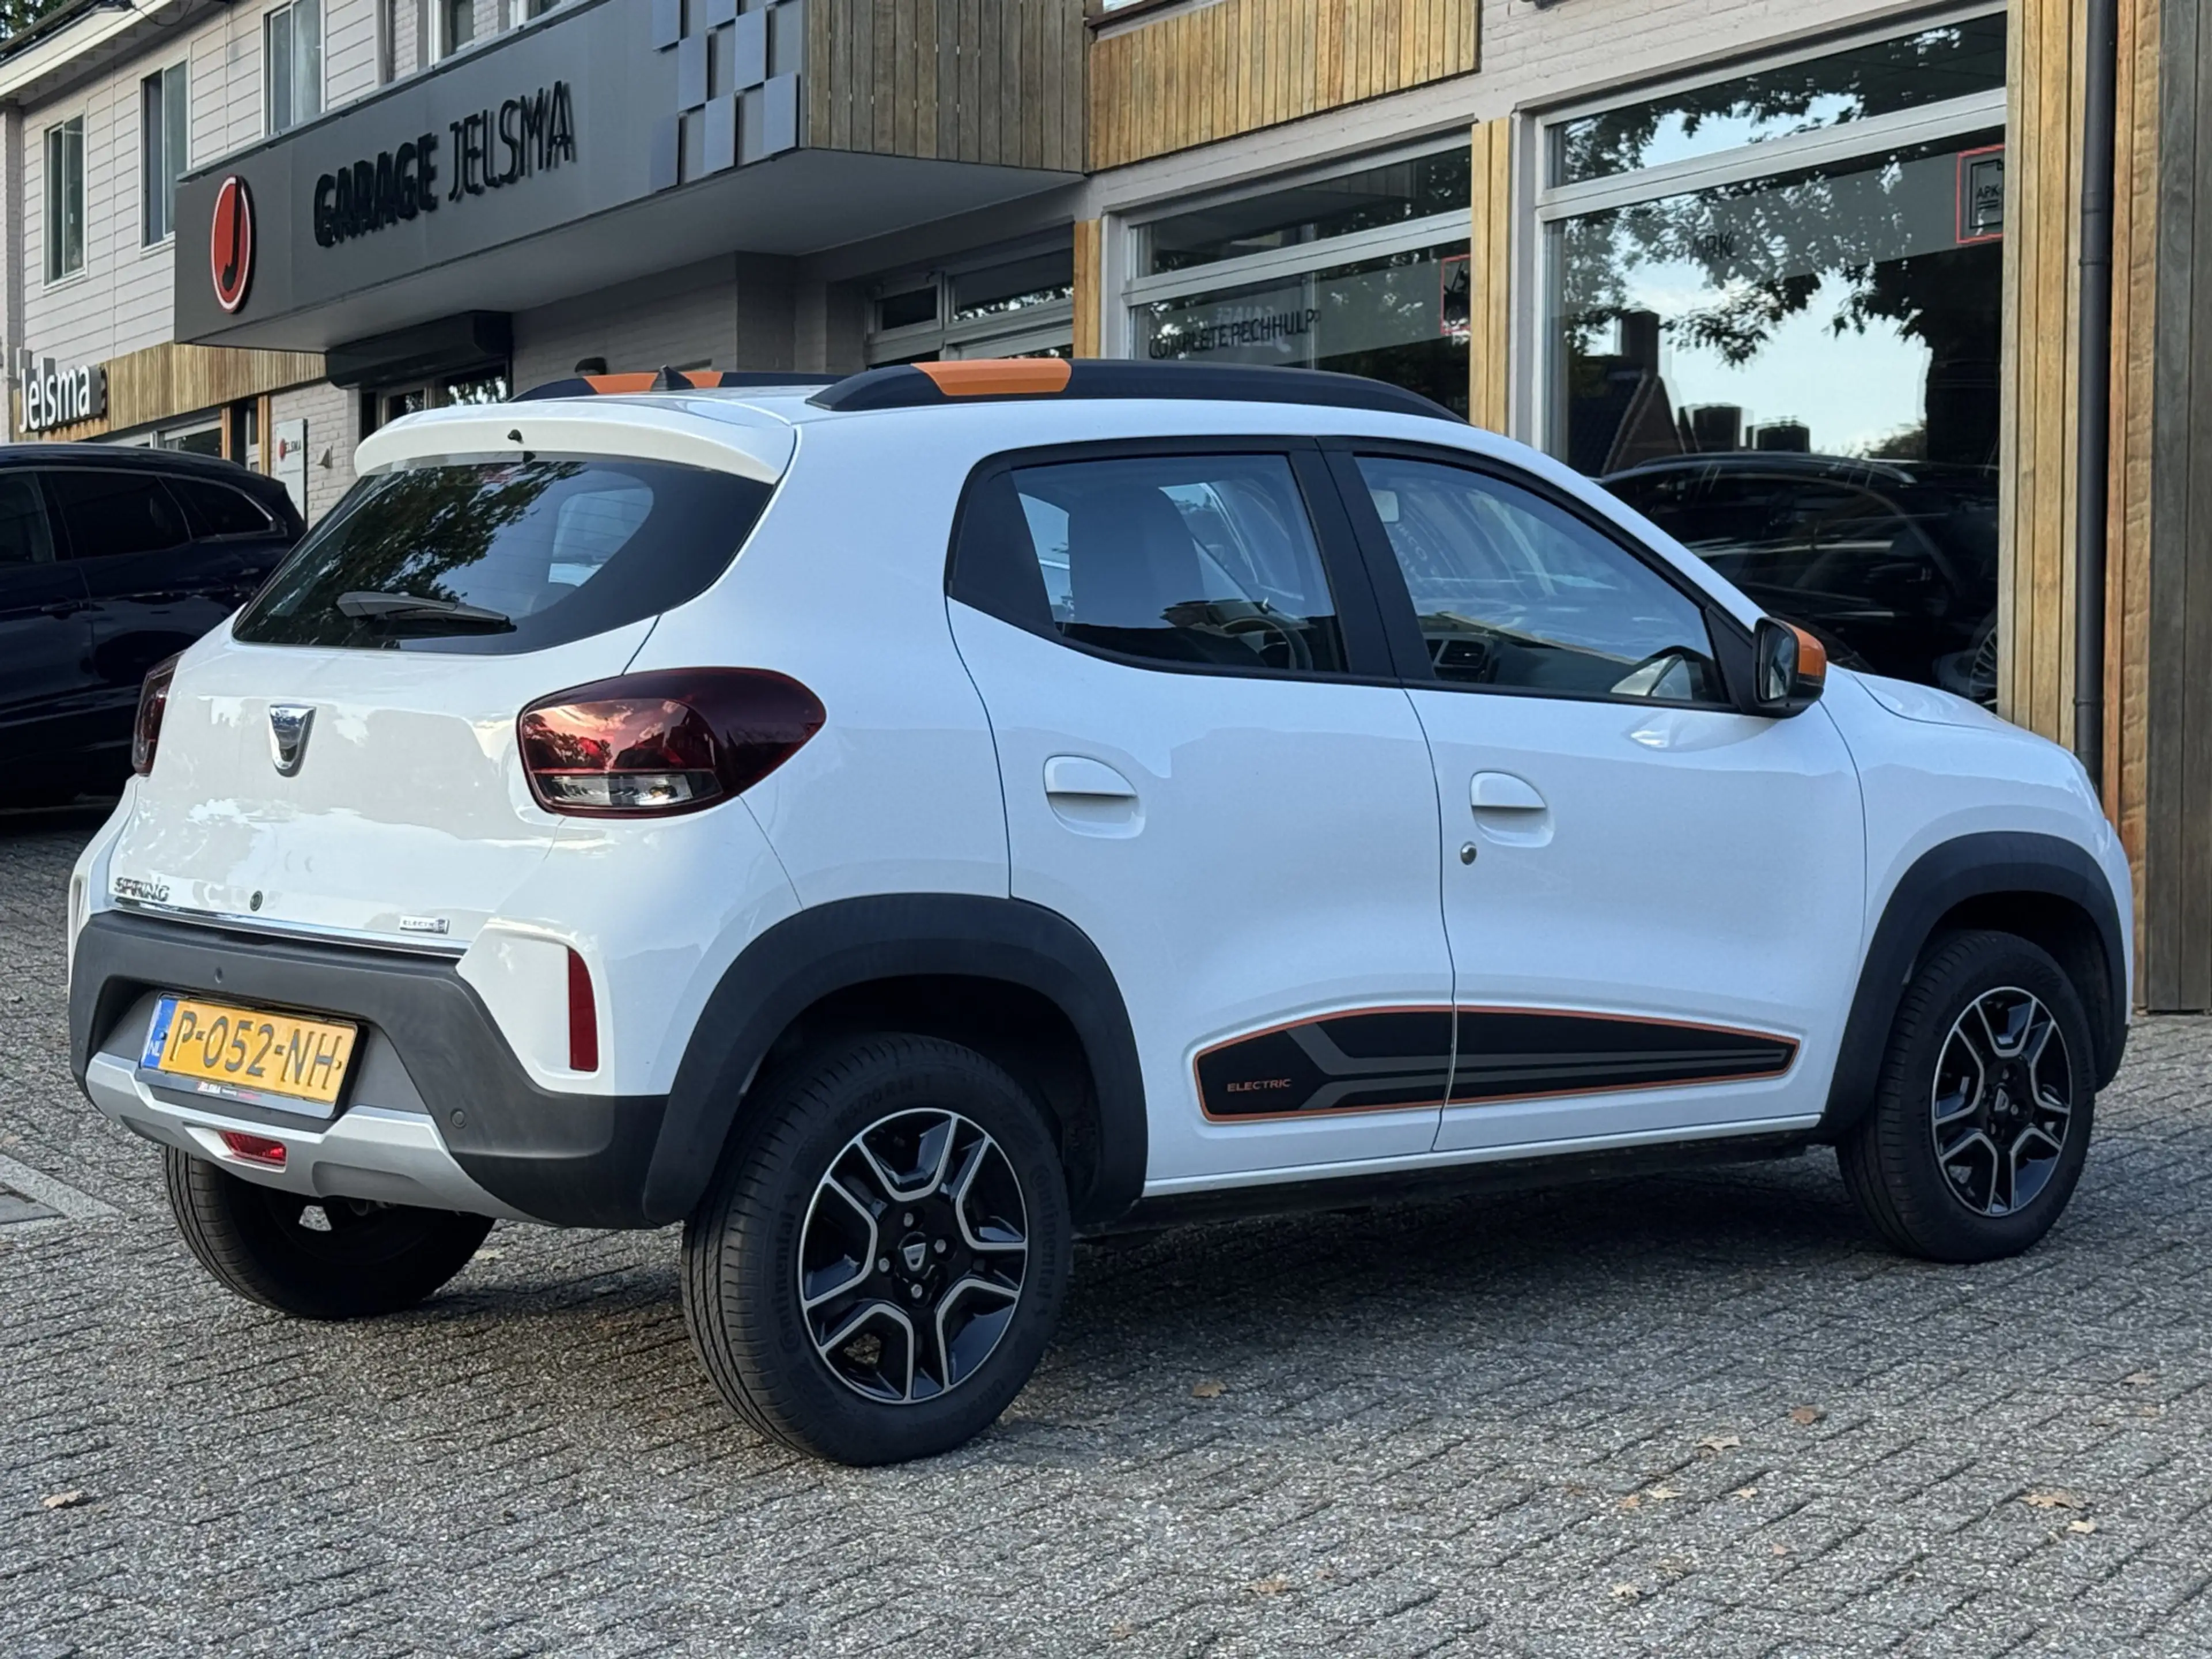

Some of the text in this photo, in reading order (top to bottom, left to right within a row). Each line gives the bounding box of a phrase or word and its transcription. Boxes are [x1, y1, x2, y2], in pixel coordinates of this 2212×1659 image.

[314, 80, 577, 248] GARAGE JELSMA
[19, 357, 90, 433] Jelsma
[114, 876, 170, 902] SPRING
[147, 1040, 160, 1057] NL
[169, 1010, 342, 1090] P-052-NH
[1227, 1078, 1291, 1092] ELECTRIC
